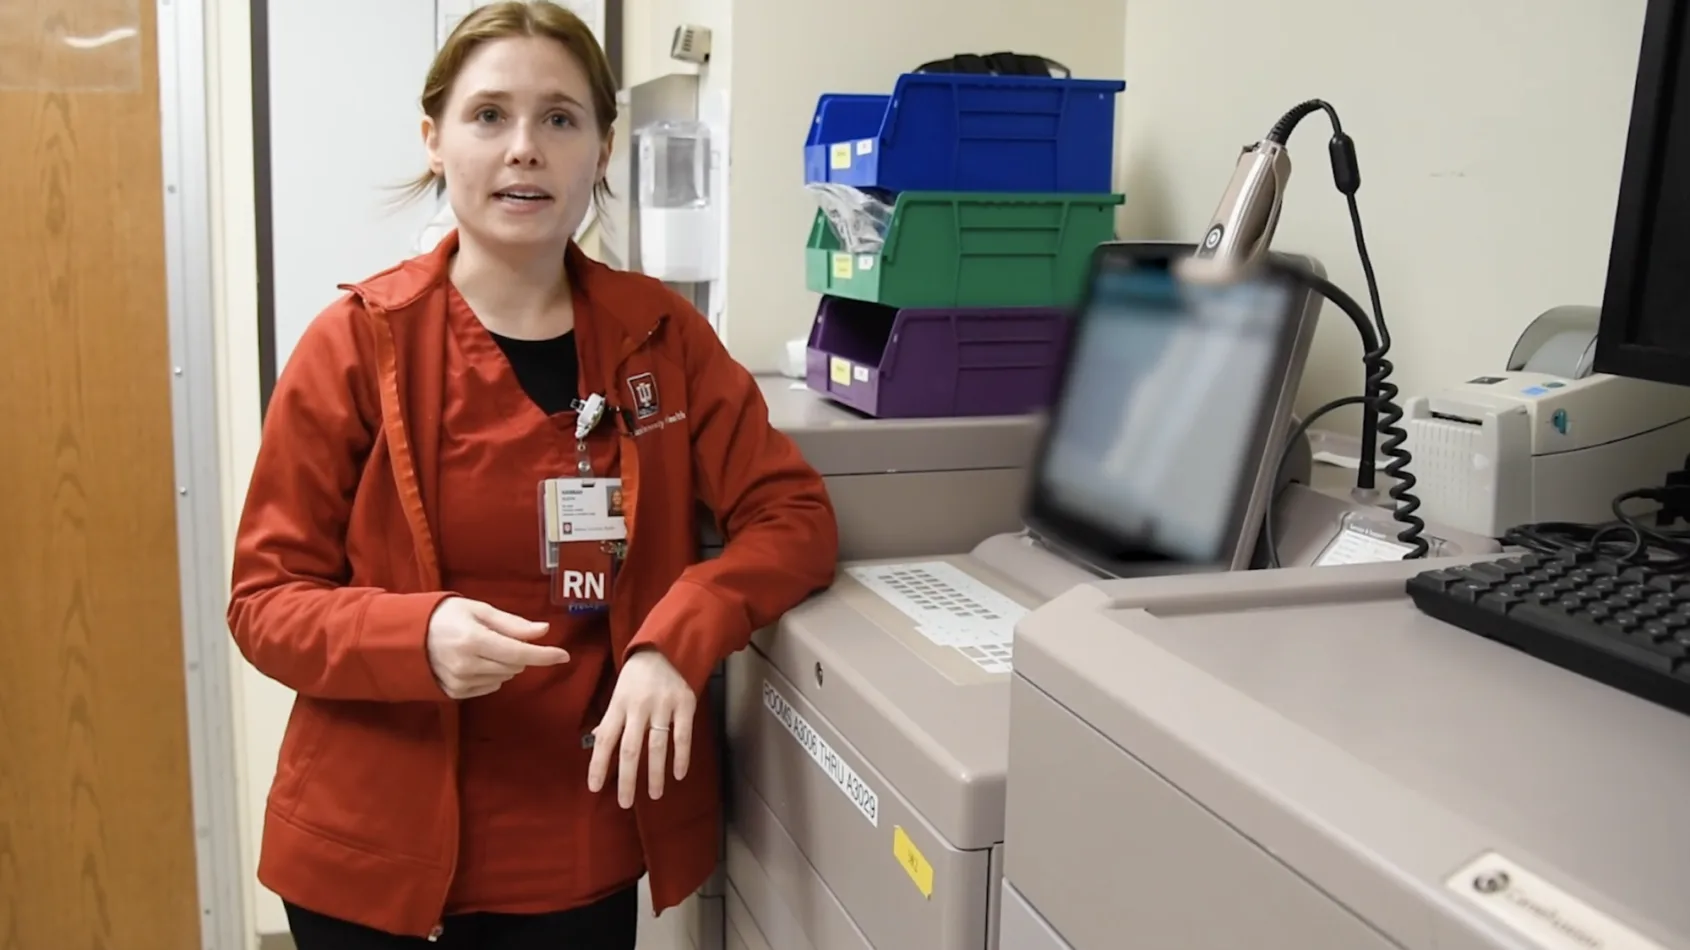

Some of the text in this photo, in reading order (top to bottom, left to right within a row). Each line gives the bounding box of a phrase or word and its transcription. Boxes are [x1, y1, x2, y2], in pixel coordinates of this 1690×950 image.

[563, 569, 605, 600] RN
[764, 682, 792, 729] ROOMS
[820, 740, 845, 785] THRU
[846, 771, 876, 820] A3029
